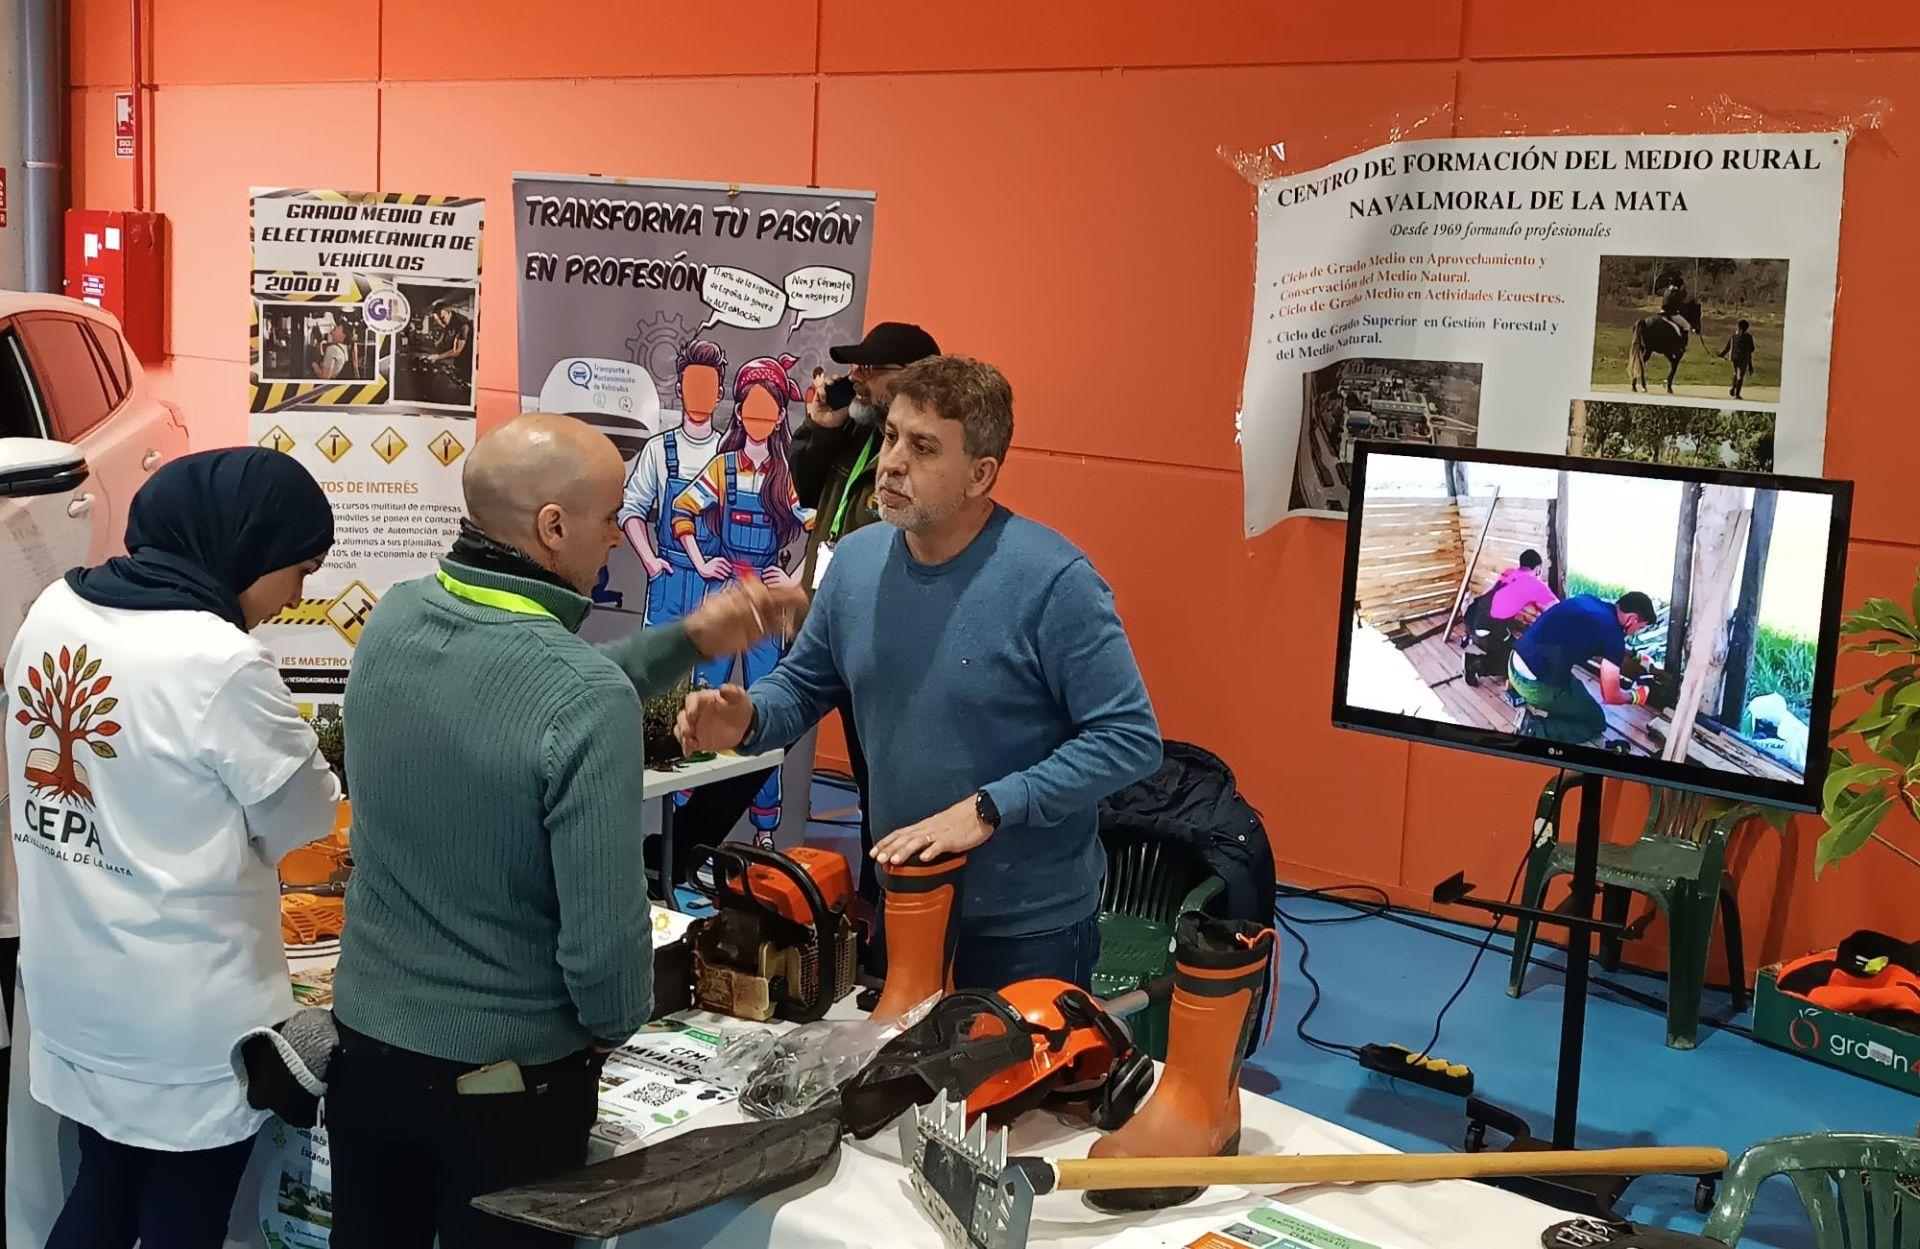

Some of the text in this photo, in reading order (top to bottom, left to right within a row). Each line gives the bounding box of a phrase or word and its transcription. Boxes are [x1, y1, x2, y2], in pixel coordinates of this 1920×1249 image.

[1277, 145, 1821, 207] CENTRO DE FORMACIÓN DEL MEDIO RURAL
[287, 204, 456, 226] GRADO MEDIO EN
[1350, 190, 1688, 219] NAVALMORAL DE LA MATA
[526, 195, 863, 245] TRANSFORMA TU PASIÓN
[1390, 221, 1611, 240] Desde 1969 formando profesionales
[262, 227, 476, 251] ELECTROMECÁNICA DE
[318, 251, 425, 271] VEHÍCULOS
[525, 250, 709, 293] EN PROFESIÓN
[1281, 252, 1547, 285] Ciclo de Grado Medio en Aprovechamiento y
[265, 276, 340, 292] 2000 H
[1280, 270, 1470, 301] Conservación del Medio Natural.
[1279, 287, 1565, 318] Ciclo de Grado Medio en Actividades Ecuestres.
[1277, 313, 1559, 343] Ciclo de Grado Superior en Gestión Forestal y
[1276, 348, 1294, 361] del
[1299, 343, 1335, 359] Medio
[320, 479, 418, 494] TOS DE INTERÉS
[371, 502, 406, 510] multitud
[408, 503, 418, 511] de
[420, 504, 462, 513] empresas
[336, 526, 369, 534] mativos
[373, 526, 384, 534] de
[383, 515, 409, 523] ponen
[332, 549, 348, 557] 10%
[417, 551, 428, 559] de
[281, 657, 296, 666] IES
[299, 657, 347, 666] MAESTRO
[25, 799, 104, 855] CEPA
[73, 853, 91, 864] DE
[1829, 1035, 1908, 1073] gron
